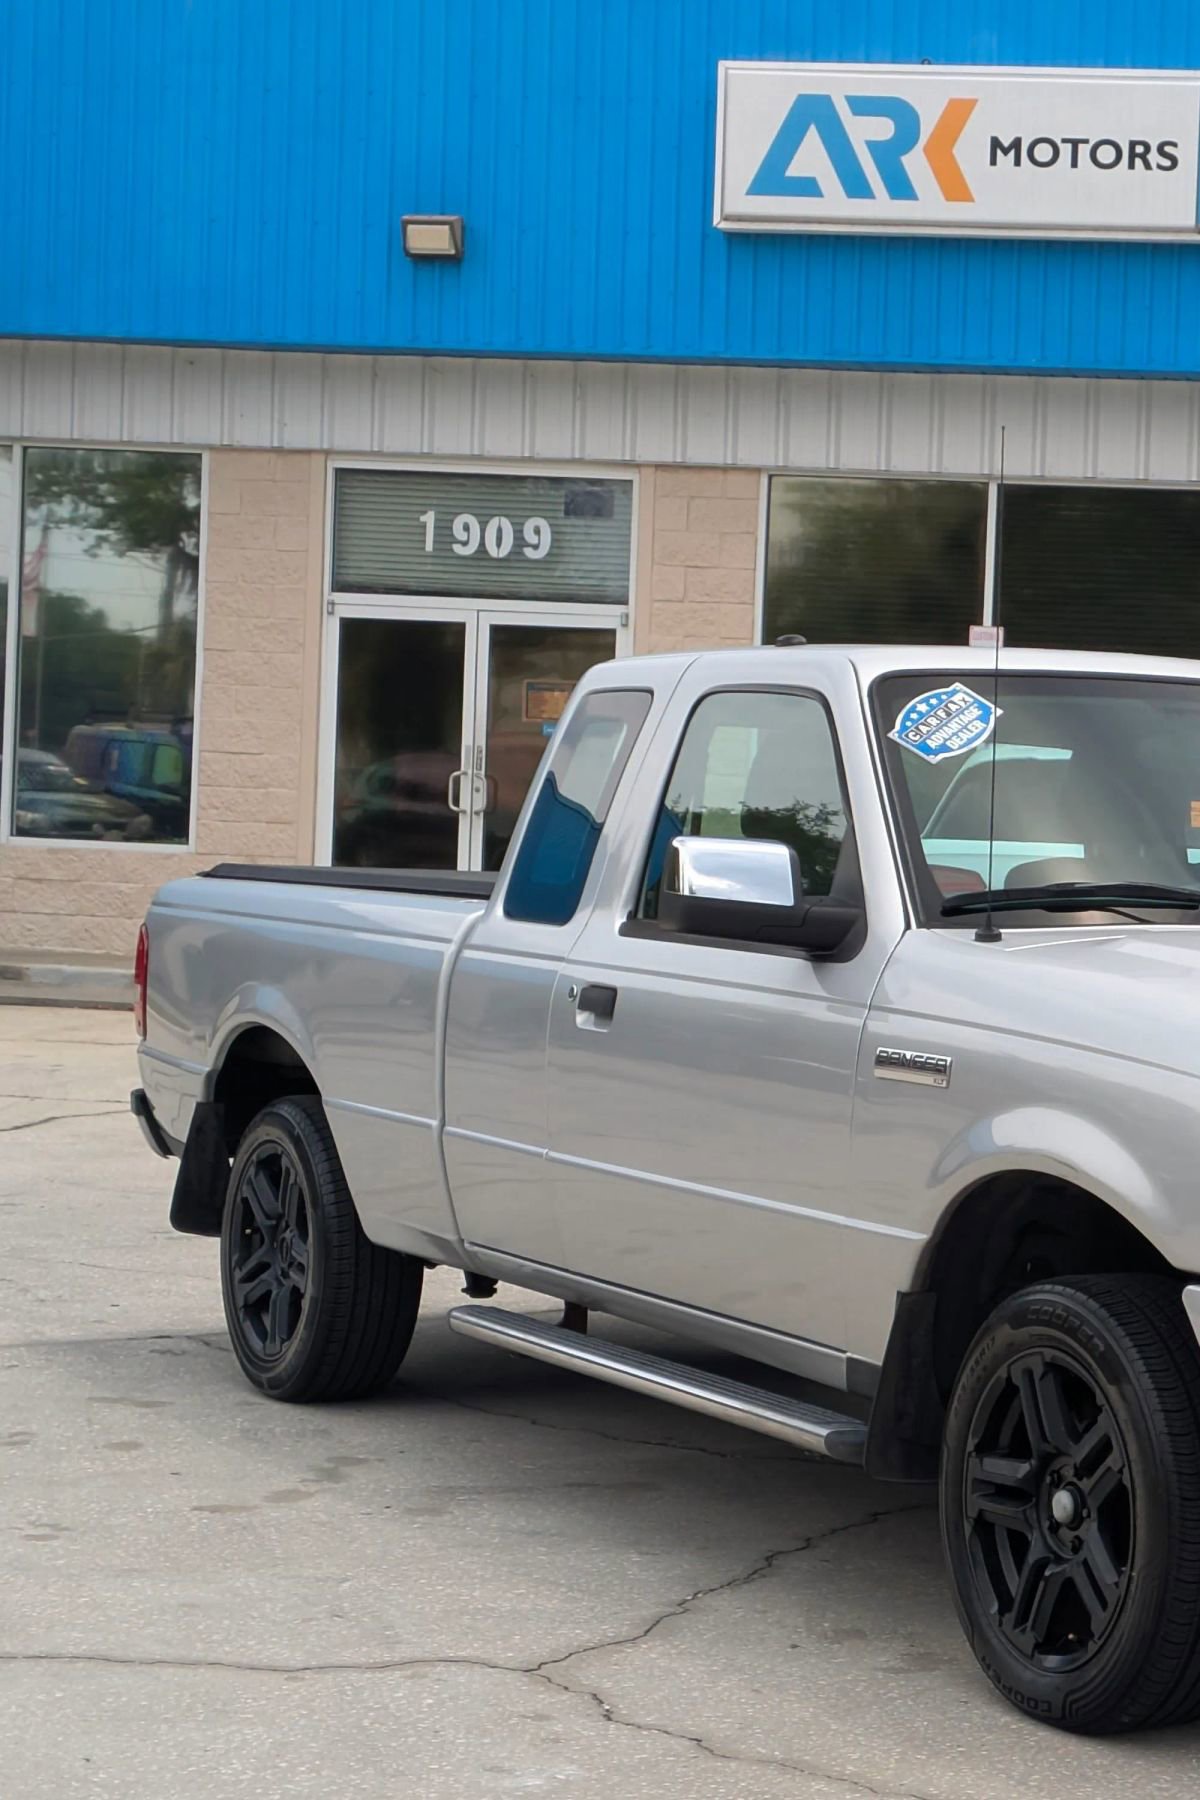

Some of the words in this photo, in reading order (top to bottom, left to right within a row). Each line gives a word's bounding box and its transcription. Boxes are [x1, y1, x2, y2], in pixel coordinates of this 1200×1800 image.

[745, 93, 979, 203] ARK
[990, 136, 1179, 172] MOTORS
[419, 510, 551, 560] 1909
[905, 694, 972, 742] CARFAX
[924, 702, 983, 751] ADVANTAGE
[944, 719, 988, 751] DEALER
[874, 1049, 948, 1075] RANGER
